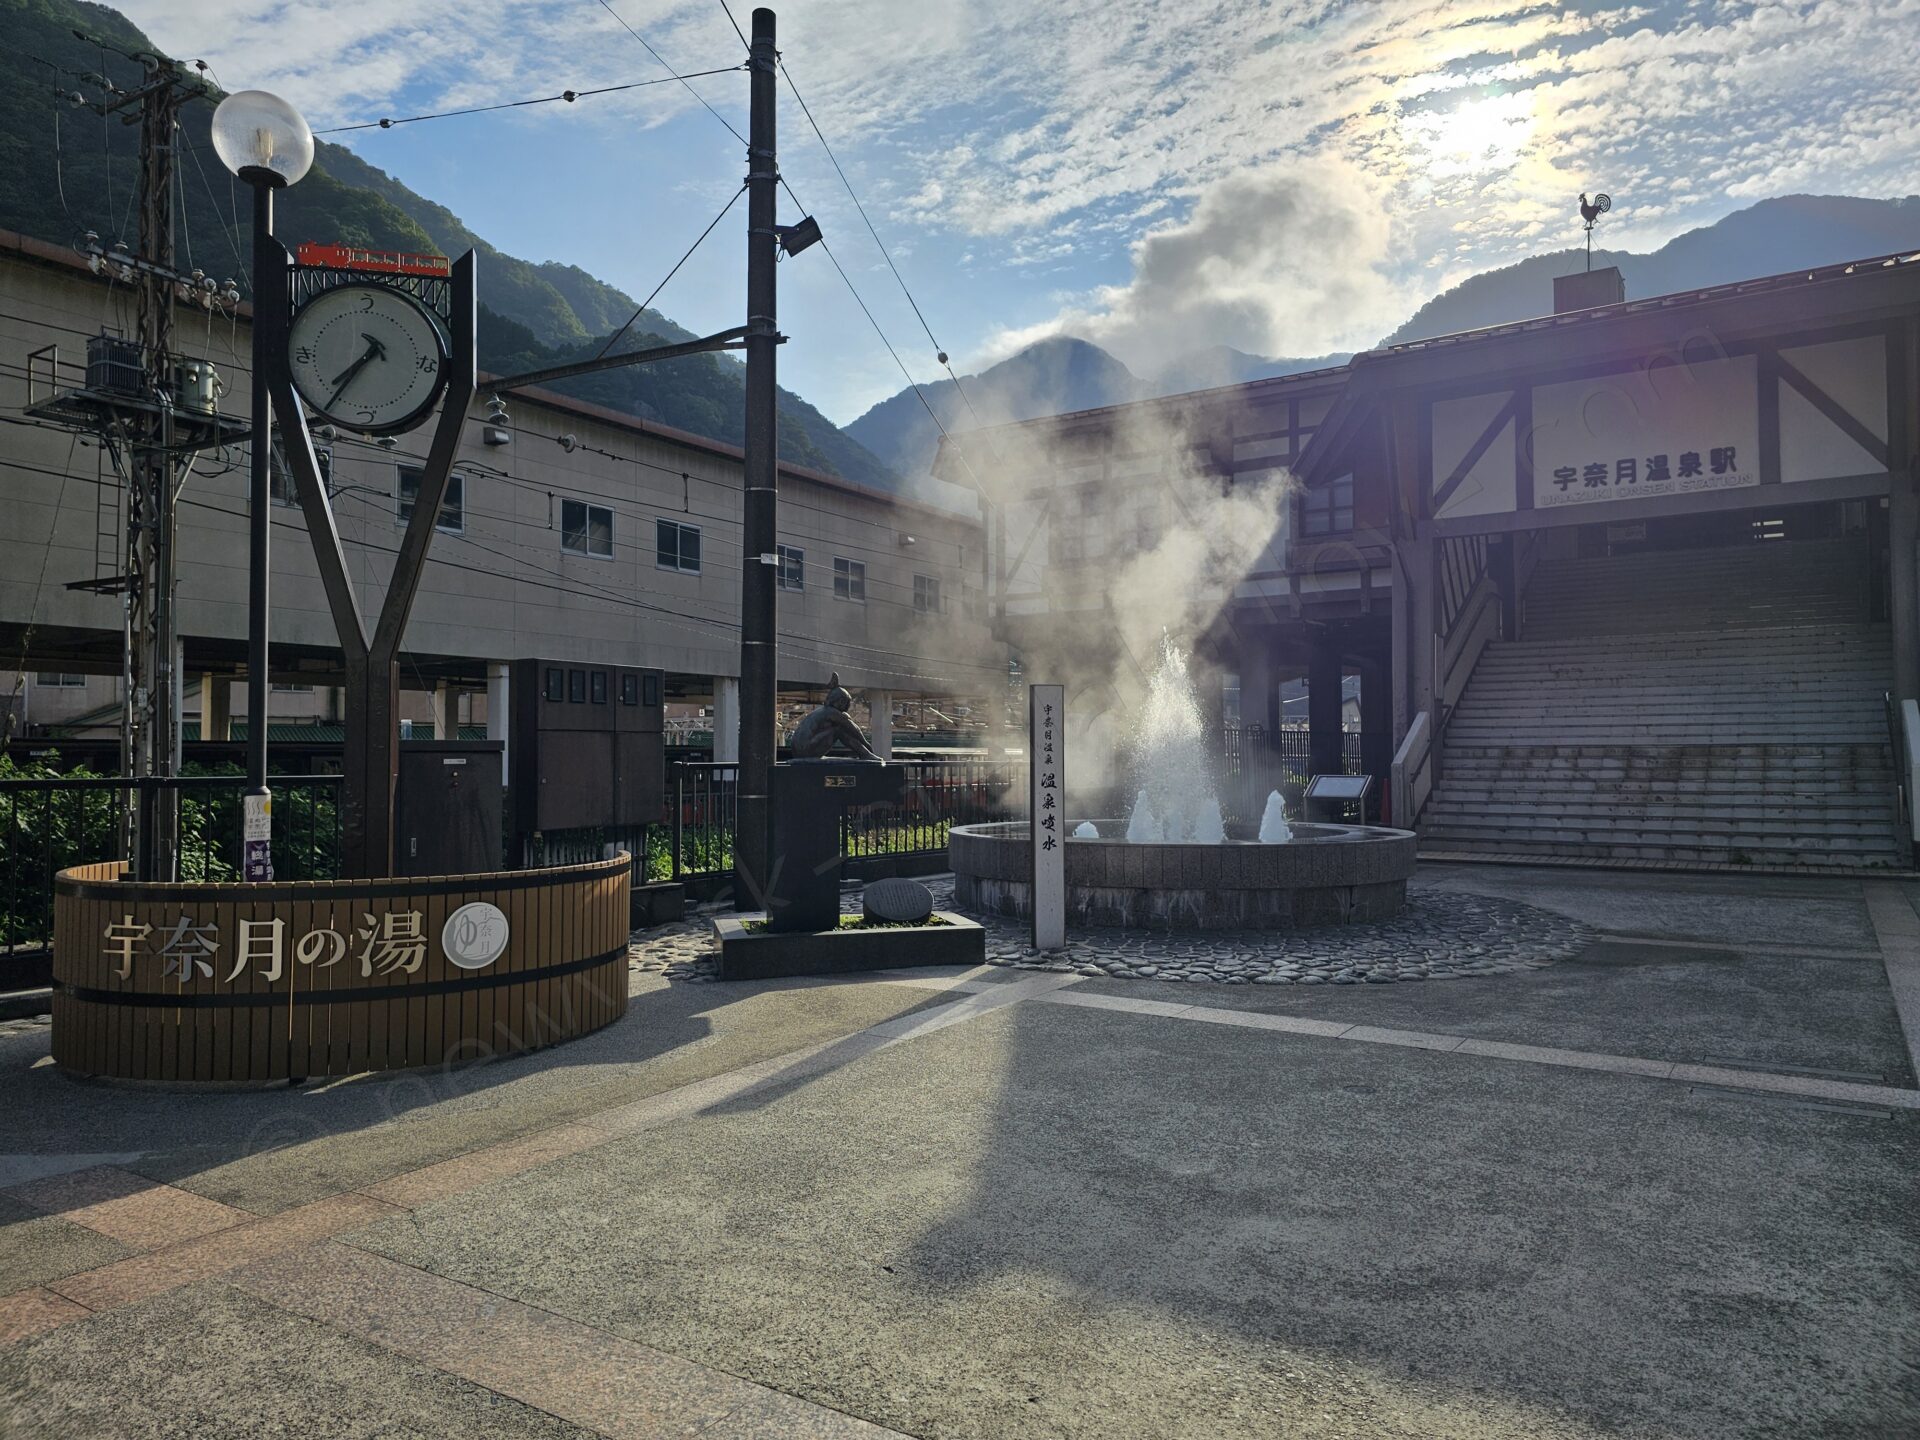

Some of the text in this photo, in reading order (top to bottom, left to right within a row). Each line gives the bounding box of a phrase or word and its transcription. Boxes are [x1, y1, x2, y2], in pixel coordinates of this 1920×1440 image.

[360, 293, 374, 311] う
[296, 346, 311, 364] き
[419, 355, 438, 373] な
[356, 410, 377, 425] づ
[1552, 445, 1738, 492] 宇奈月温泉駅
[1540, 472, 1753, 507] UNAZUKI ONSEN STATION
[1041, 703, 1058, 852] 宇奈月温泉 温泉噴水
[102, 908, 429, 984] 宇奈月の湯
[480, 907, 494, 954] 宇奈月
